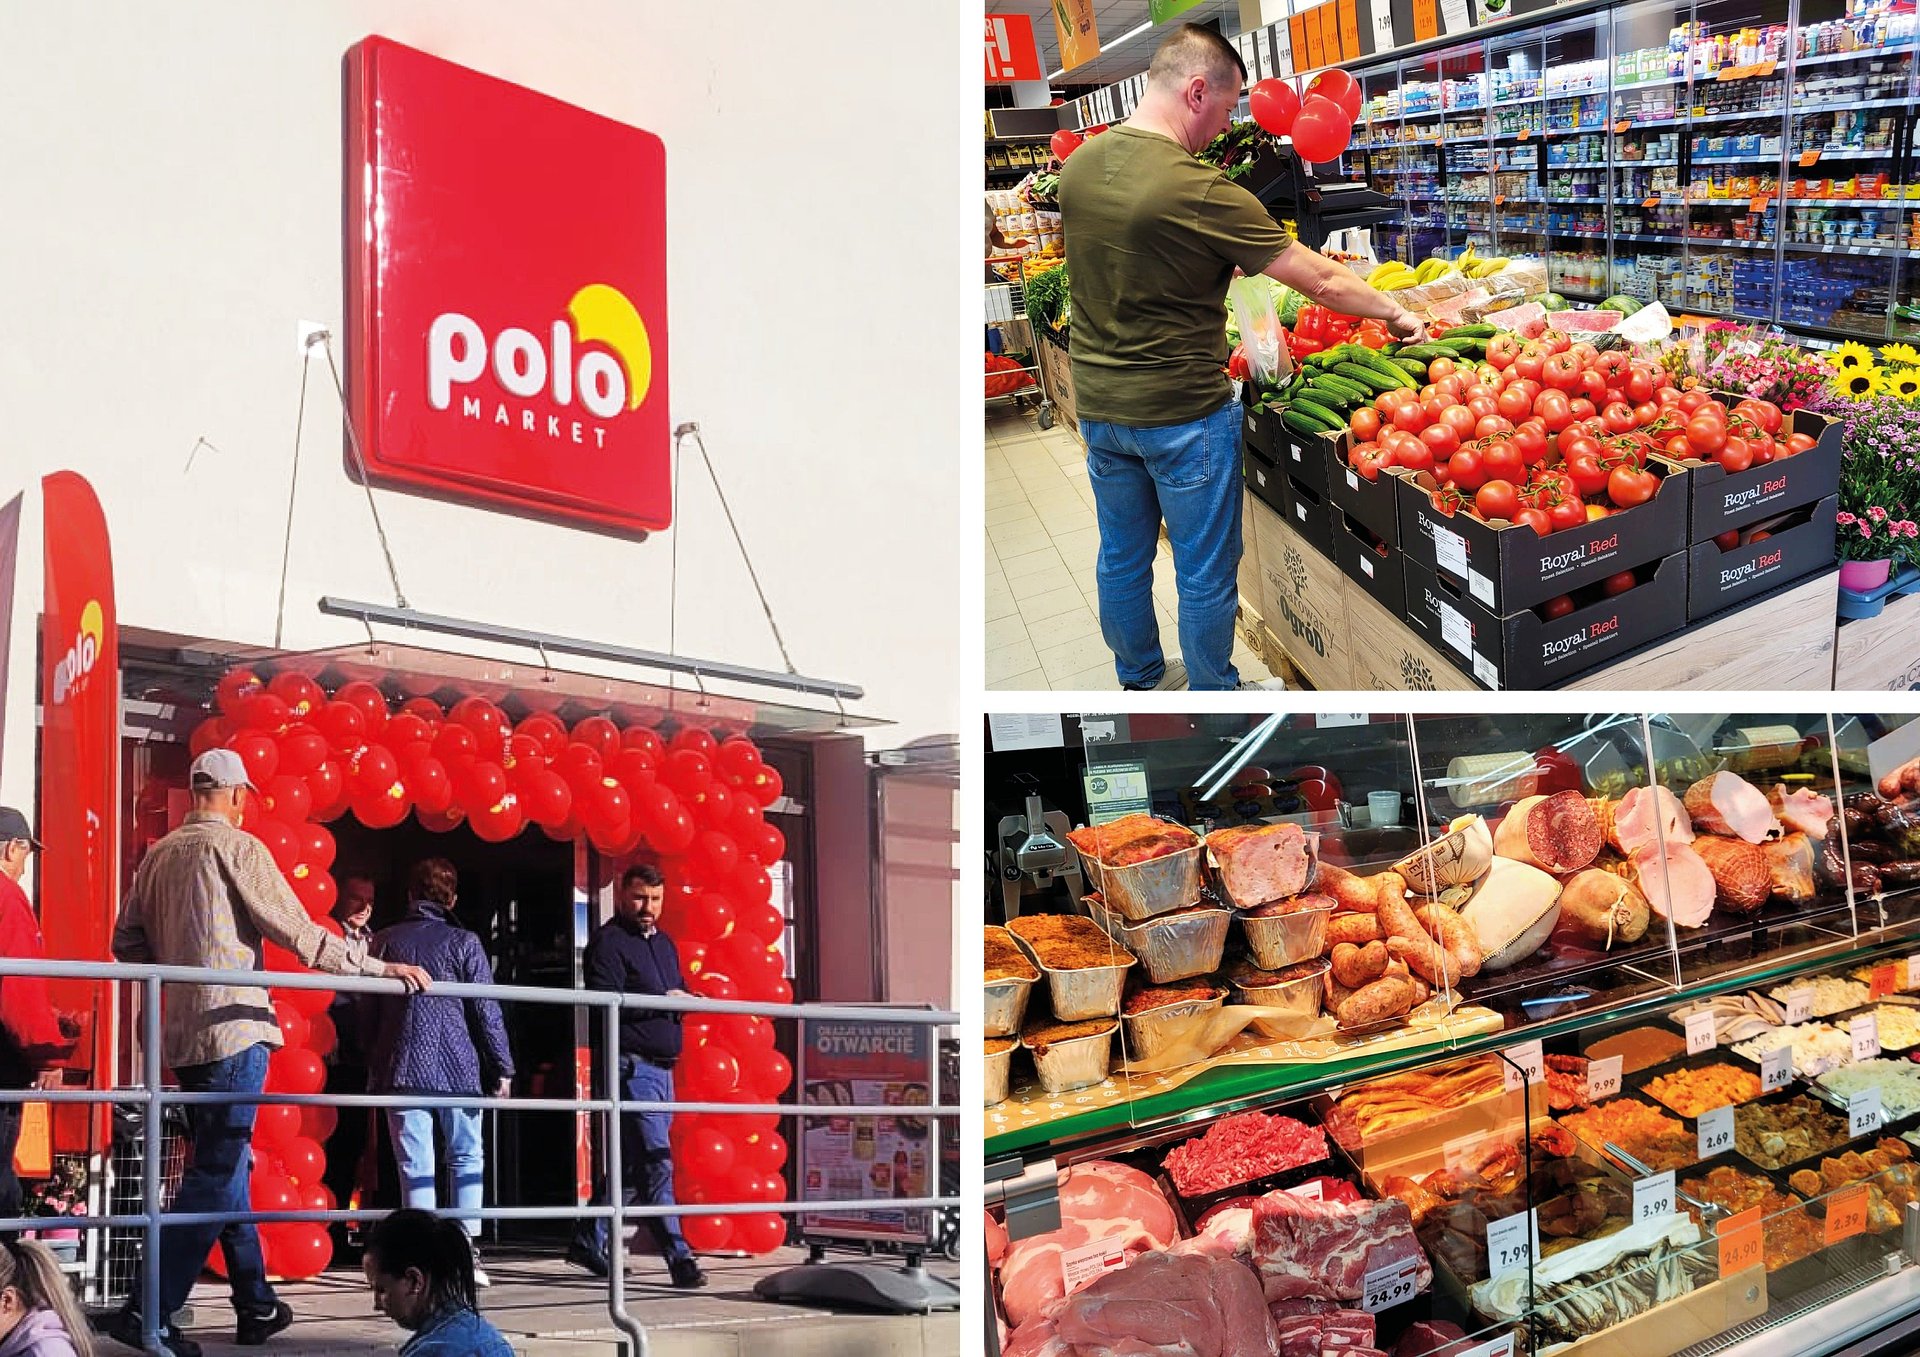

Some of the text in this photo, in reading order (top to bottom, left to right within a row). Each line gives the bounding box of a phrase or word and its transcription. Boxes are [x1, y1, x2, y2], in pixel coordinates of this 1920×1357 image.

[1378, 15, 1391, 31] 7.99
[427, 312, 626, 419] polo
[463, 396, 606, 449] MARKET
[1723, 476, 1786, 508] Royal Red
[1540, 533, 1619, 573] Royal Red
[1719, 549, 1782, 584] Royal Red
[1266, 568, 1335, 649] zaczarowany
[1542, 615, 1619, 658] Royal Red
[818, 1036, 914, 1053] OTWARCIE
[1695, 1032, 1711, 1046] 1.99
[1858, 1039, 1875, 1051] 2.79
[1594, 1078, 1615, 1092] 9.99
[1768, 1069, 1787, 1084] 2.49
[1856, 1112, 1876, 1128] 2.39
[1706, 1131, 1728, 1149] 2.69
[1643, 1198, 1668, 1218] 3.99
[1833, 1212, 1859, 1231] 2.39
[1500, 1243, 1529, 1265] 7.99
[1724, 1240, 1757, 1265] 24.90
[1370, 1281, 1411, 1307] 24.99
